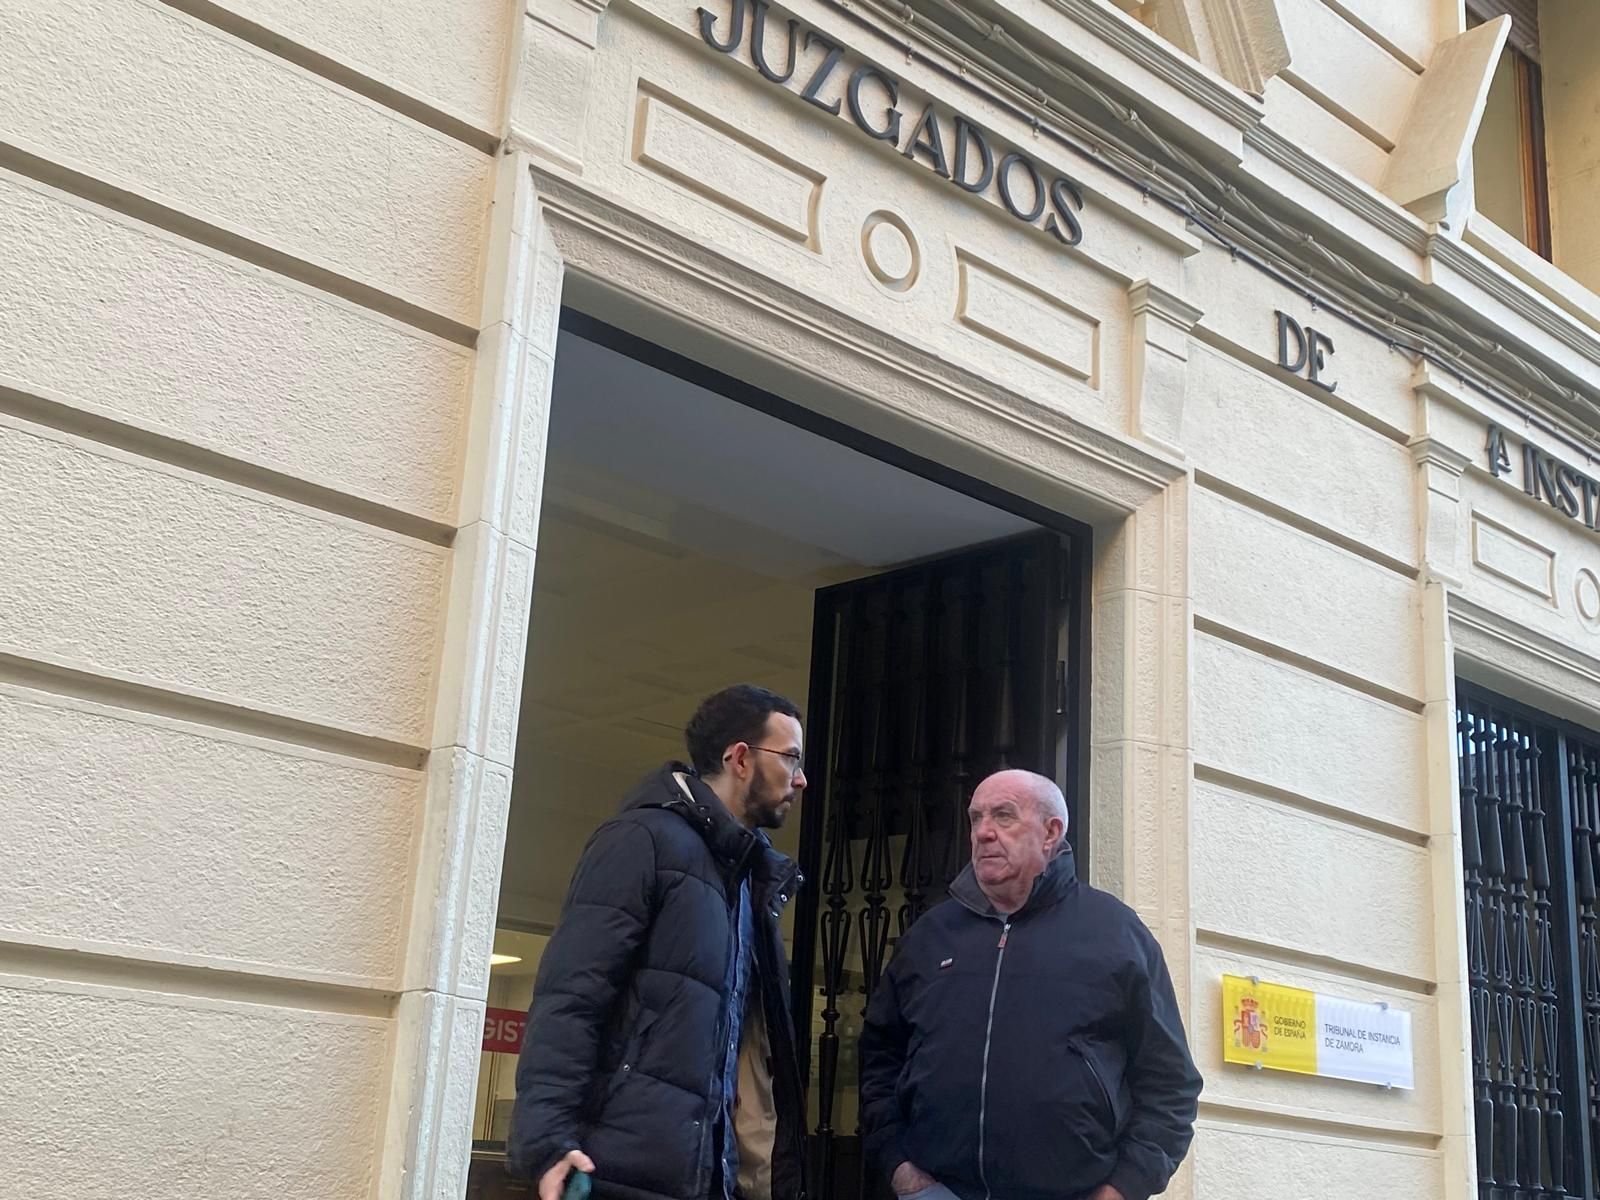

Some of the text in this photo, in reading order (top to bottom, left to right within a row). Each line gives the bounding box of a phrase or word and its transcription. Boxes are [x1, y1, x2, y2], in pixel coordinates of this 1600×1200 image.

[697, 0, 1084, 246] JUZGADOS
[1274, 309, 1335, 392] DE
[1522, 443, 1600, 532] INST
[1274, 1015, 1306, 1029] GOBIERNO
[1274, 1026, 1306, 1040] DE ESPAÑA
[1325, 1023, 1400, 1046] TRIBUNAL DE INSTANCIA
[1325, 1037, 1364, 1053] DE ZAMORA
